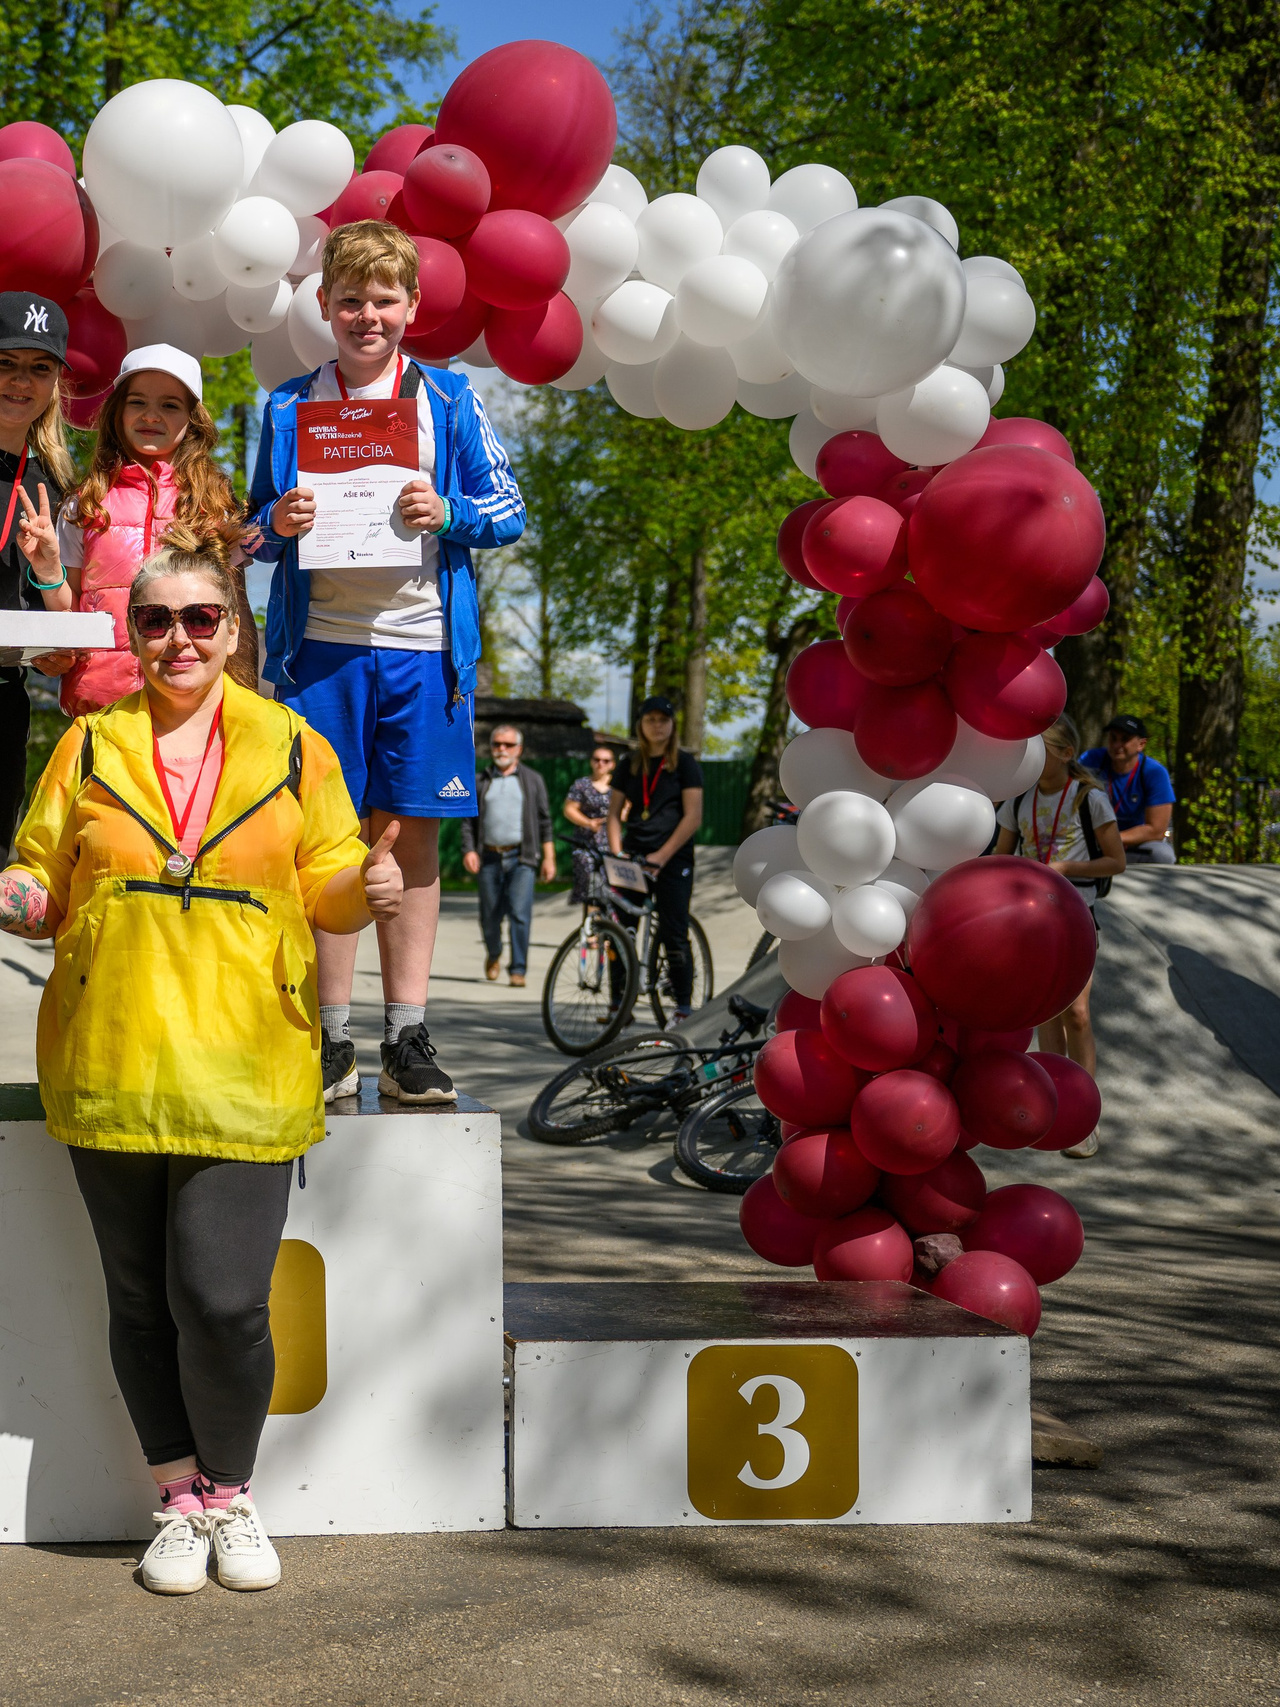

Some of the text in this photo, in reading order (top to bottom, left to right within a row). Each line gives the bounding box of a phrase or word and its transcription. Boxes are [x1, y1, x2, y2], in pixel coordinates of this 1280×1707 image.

[323, 443, 394, 459] PATEICĪBA
[343, 490, 358, 498] AŠIE
[736, 1374, 811, 1490] 3
